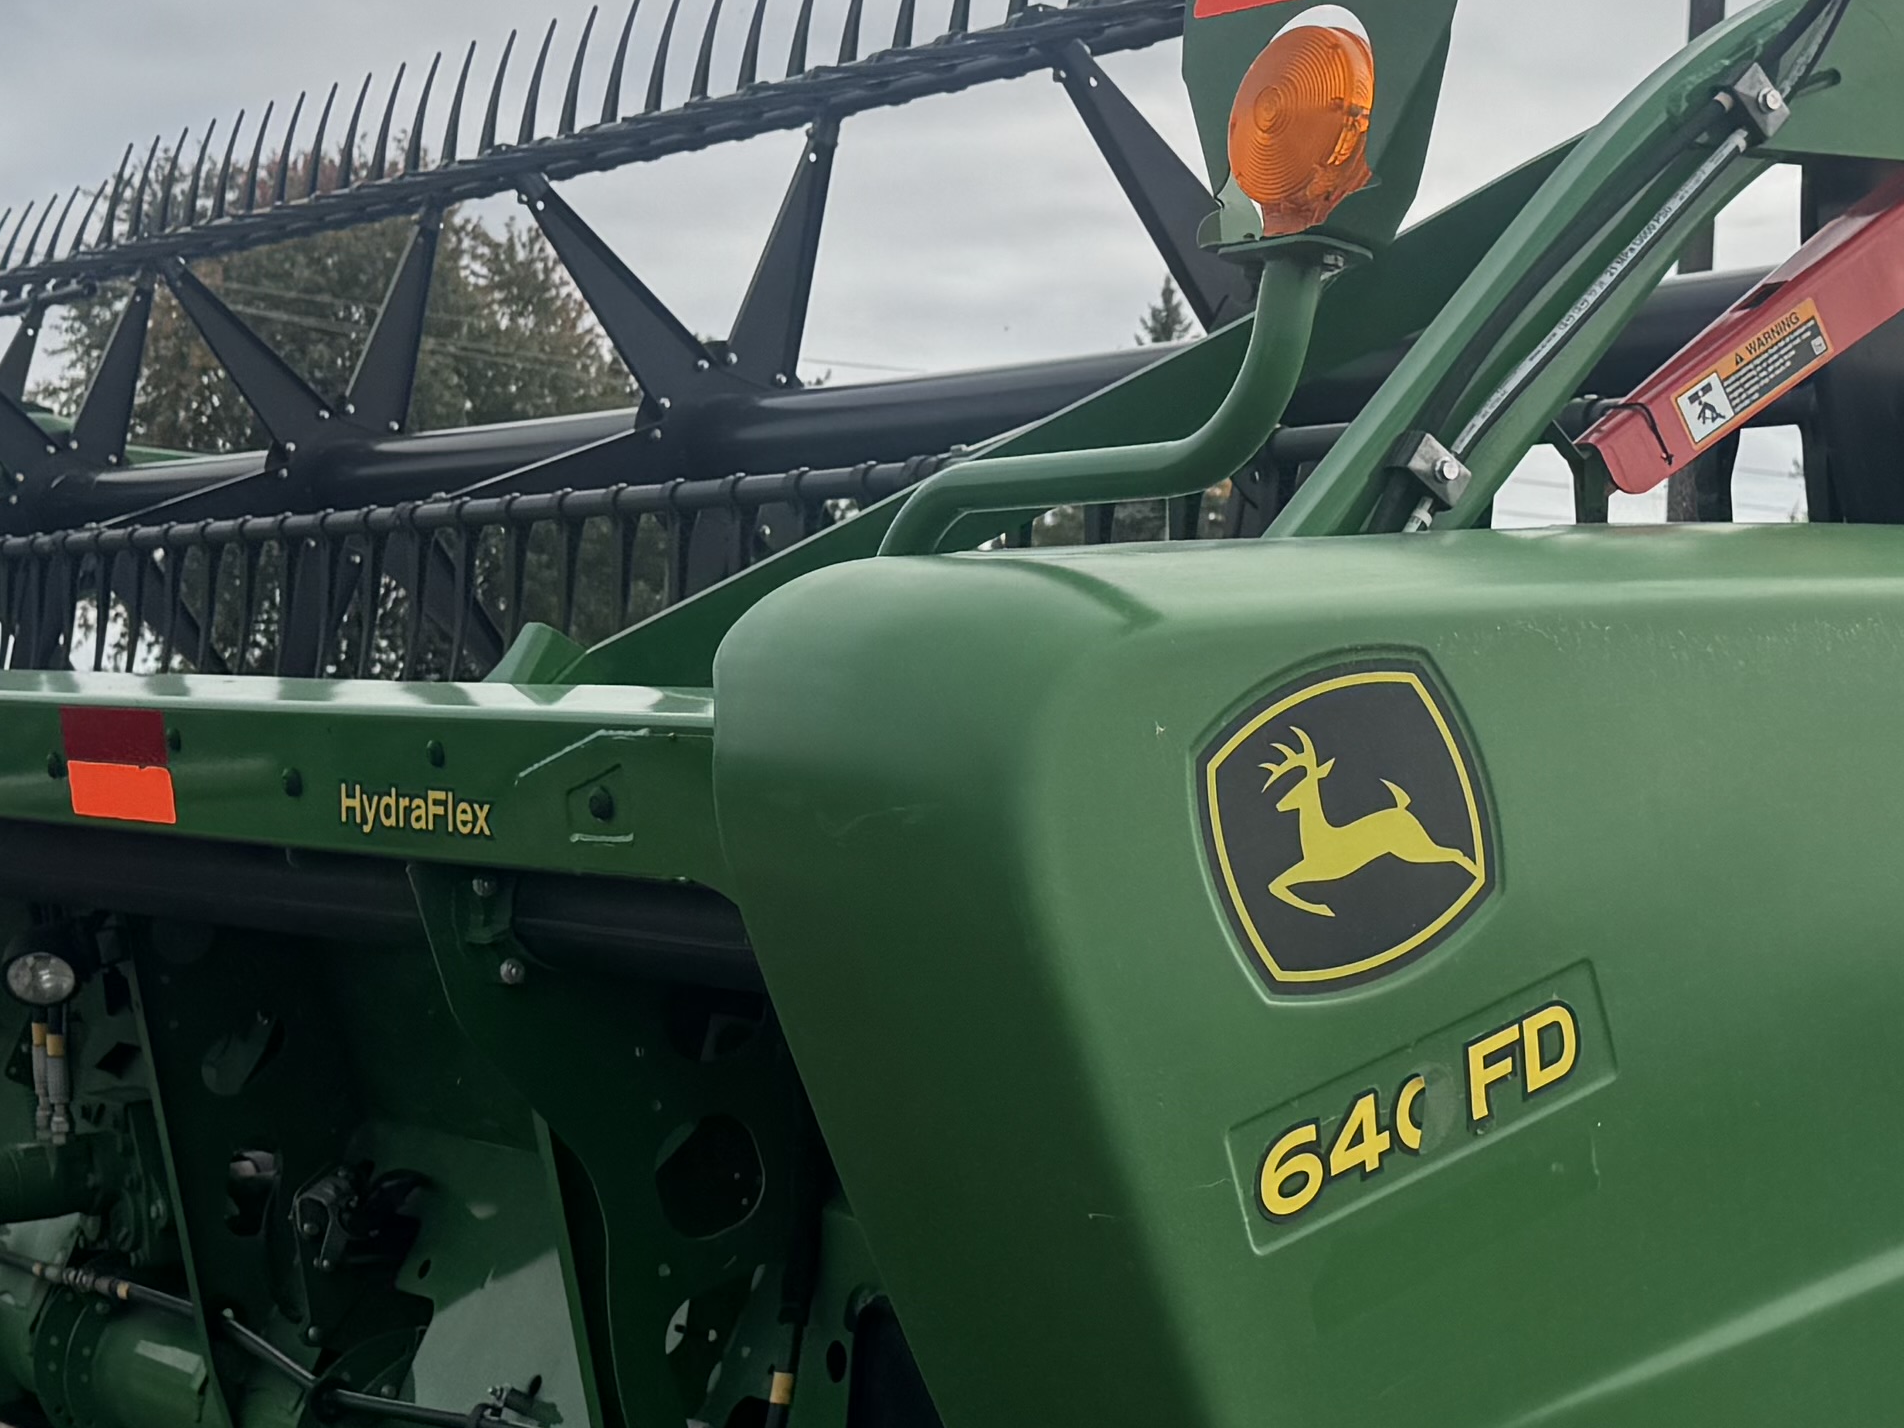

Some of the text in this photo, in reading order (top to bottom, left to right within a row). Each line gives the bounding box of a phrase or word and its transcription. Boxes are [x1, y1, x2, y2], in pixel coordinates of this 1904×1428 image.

[1745, 311, 1800, 356] WARNING
[340, 782, 491, 835] HydraFlex
[1466, 1003, 1578, 1122] FD
